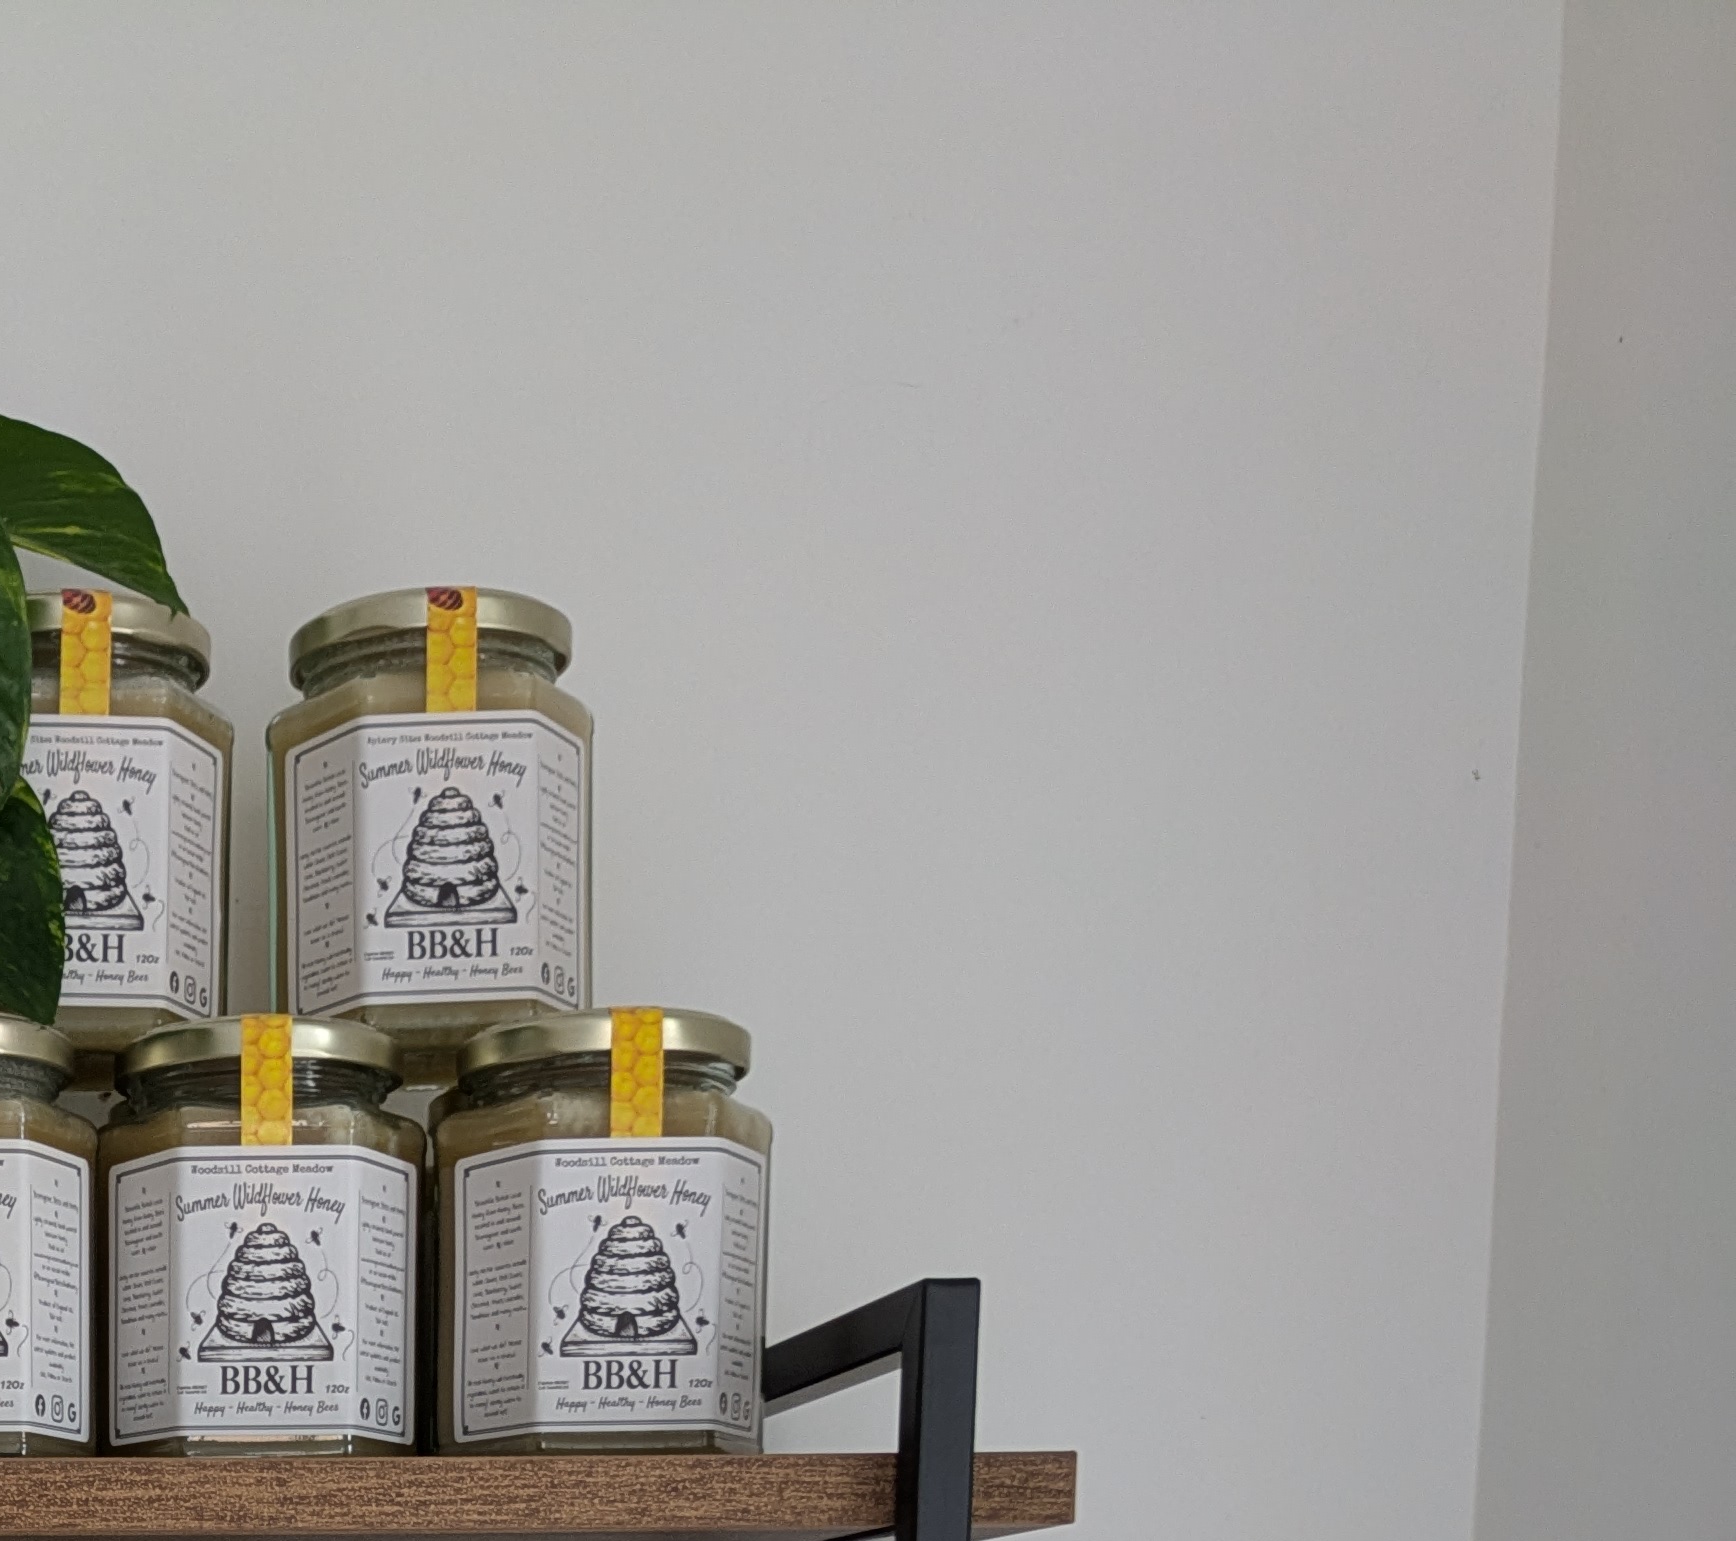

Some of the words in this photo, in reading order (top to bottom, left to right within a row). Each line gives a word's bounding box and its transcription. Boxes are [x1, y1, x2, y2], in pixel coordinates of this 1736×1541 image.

[46, 748, 115, 785] Wildflower
[117, 755, 157, 795] Honey
[358, 758, 413, 789] Summer
[416, 746, 486, 782] Wildflower
[486, 749, 528, 788] Honey
[64, 933, 125, 963] B&H
[406, 927, 499, 960] BB&H
[95, 969, 125, 986] Honey
[127, 970, 149, 983] Bees
[382, 967, 413, 982] Happy
[422, 965, 459, 980] Healthy
[469, 964, 499, 979] Honey
[501, 962, 524, 975] Bees
[245, 1164, 289, 1176] Cottage
[291, 1164, 334, 1174] Meadow
[609, 1157, 655, 1169] Cottage
[657, 1156, 700, 1166] Meadow
[175, 1194, 230, 1222] Summer
[232, 1182, 304, 1217] Wildflower
[304, 1186, 346, 1225] Honey
[537, 1188, 594, 1216] Summer
[597, 1174, 669, 1210] Wildflower
[669, 1179, 712, 1218] Honey
[219, 1365, 315, 1396] BB&H
[581, 1359, 679, 1390] BB&H
[194, 1401, 226, 1417] Happy
[235, 1400, 274, 1417] Healthy
[283, 1400, 314, 1417] Honey
[316, 1400, 339, 1414] Bees
[556, 1397, 588, 1412] Happy
[597, 1397, 636, 1412] Healthy
[646, 1396, 677, 1411] Honey
[679, 1395, 702, 1409] Bees
